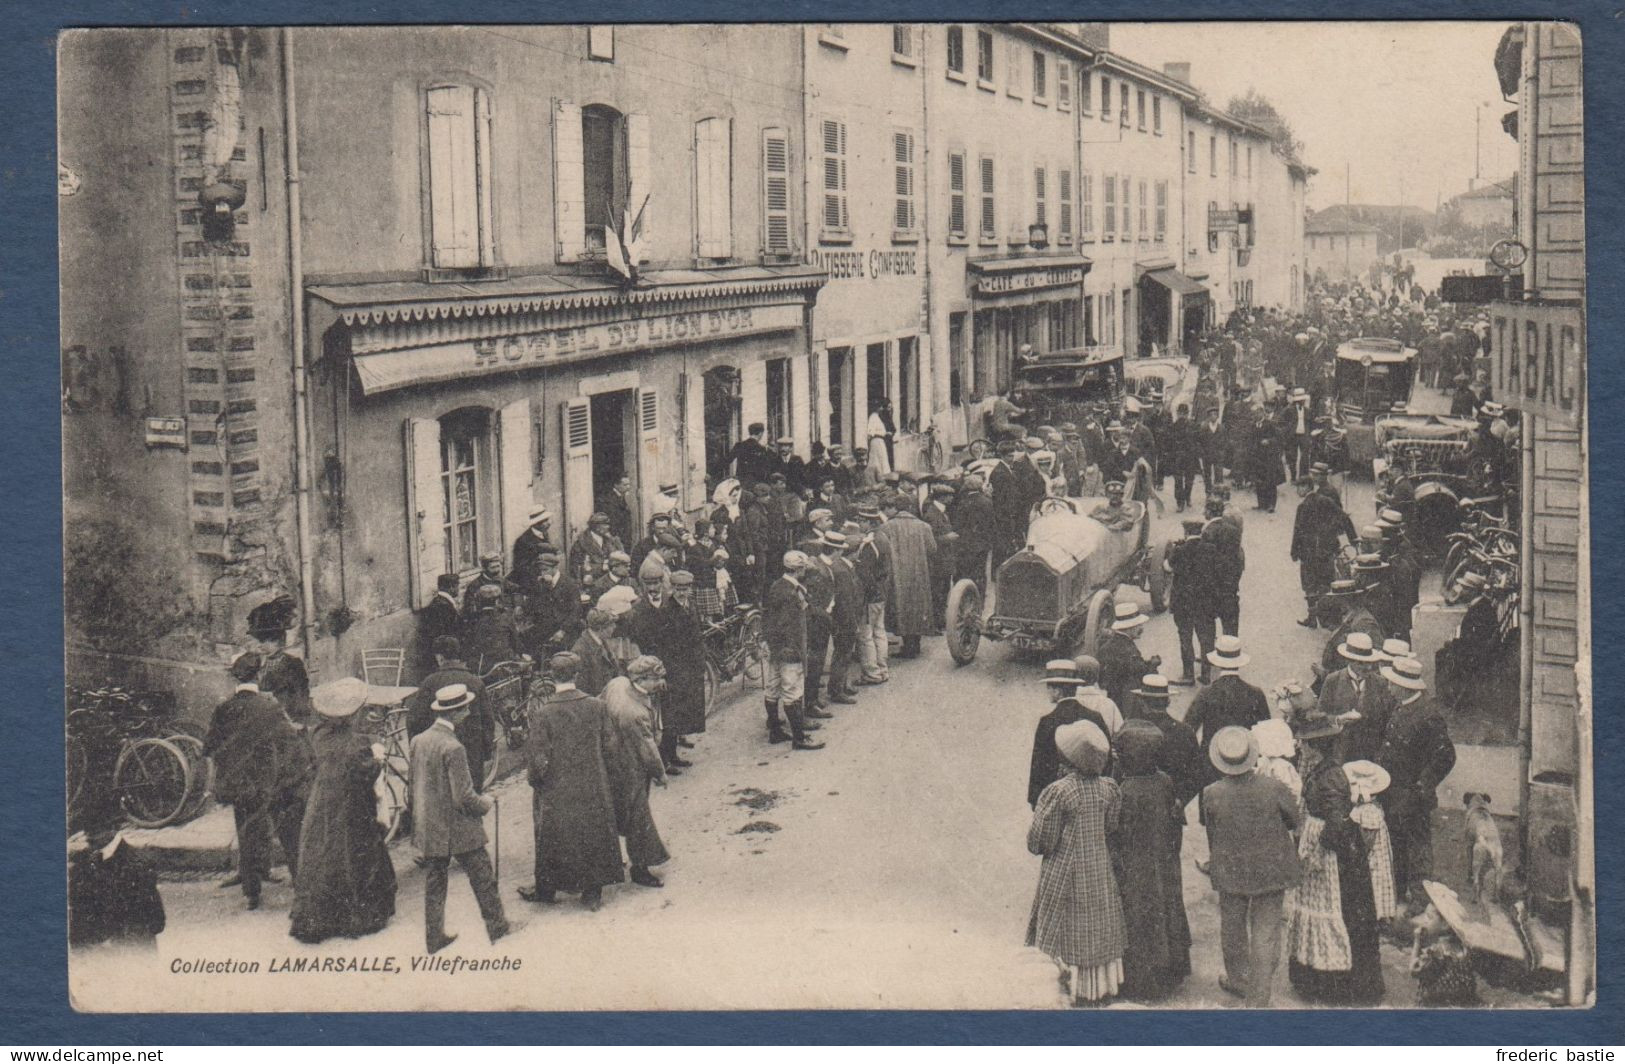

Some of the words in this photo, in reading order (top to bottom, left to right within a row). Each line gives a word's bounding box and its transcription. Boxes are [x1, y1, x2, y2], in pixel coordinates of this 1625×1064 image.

[869, 249, 917, 279] CONFISERIE
[608, 322, 639, 347] DU
[647, 313, 702, 340] LION
[708, 307, 754, 332] D'OR
[1494, 315, 1575, 412] TABAC
